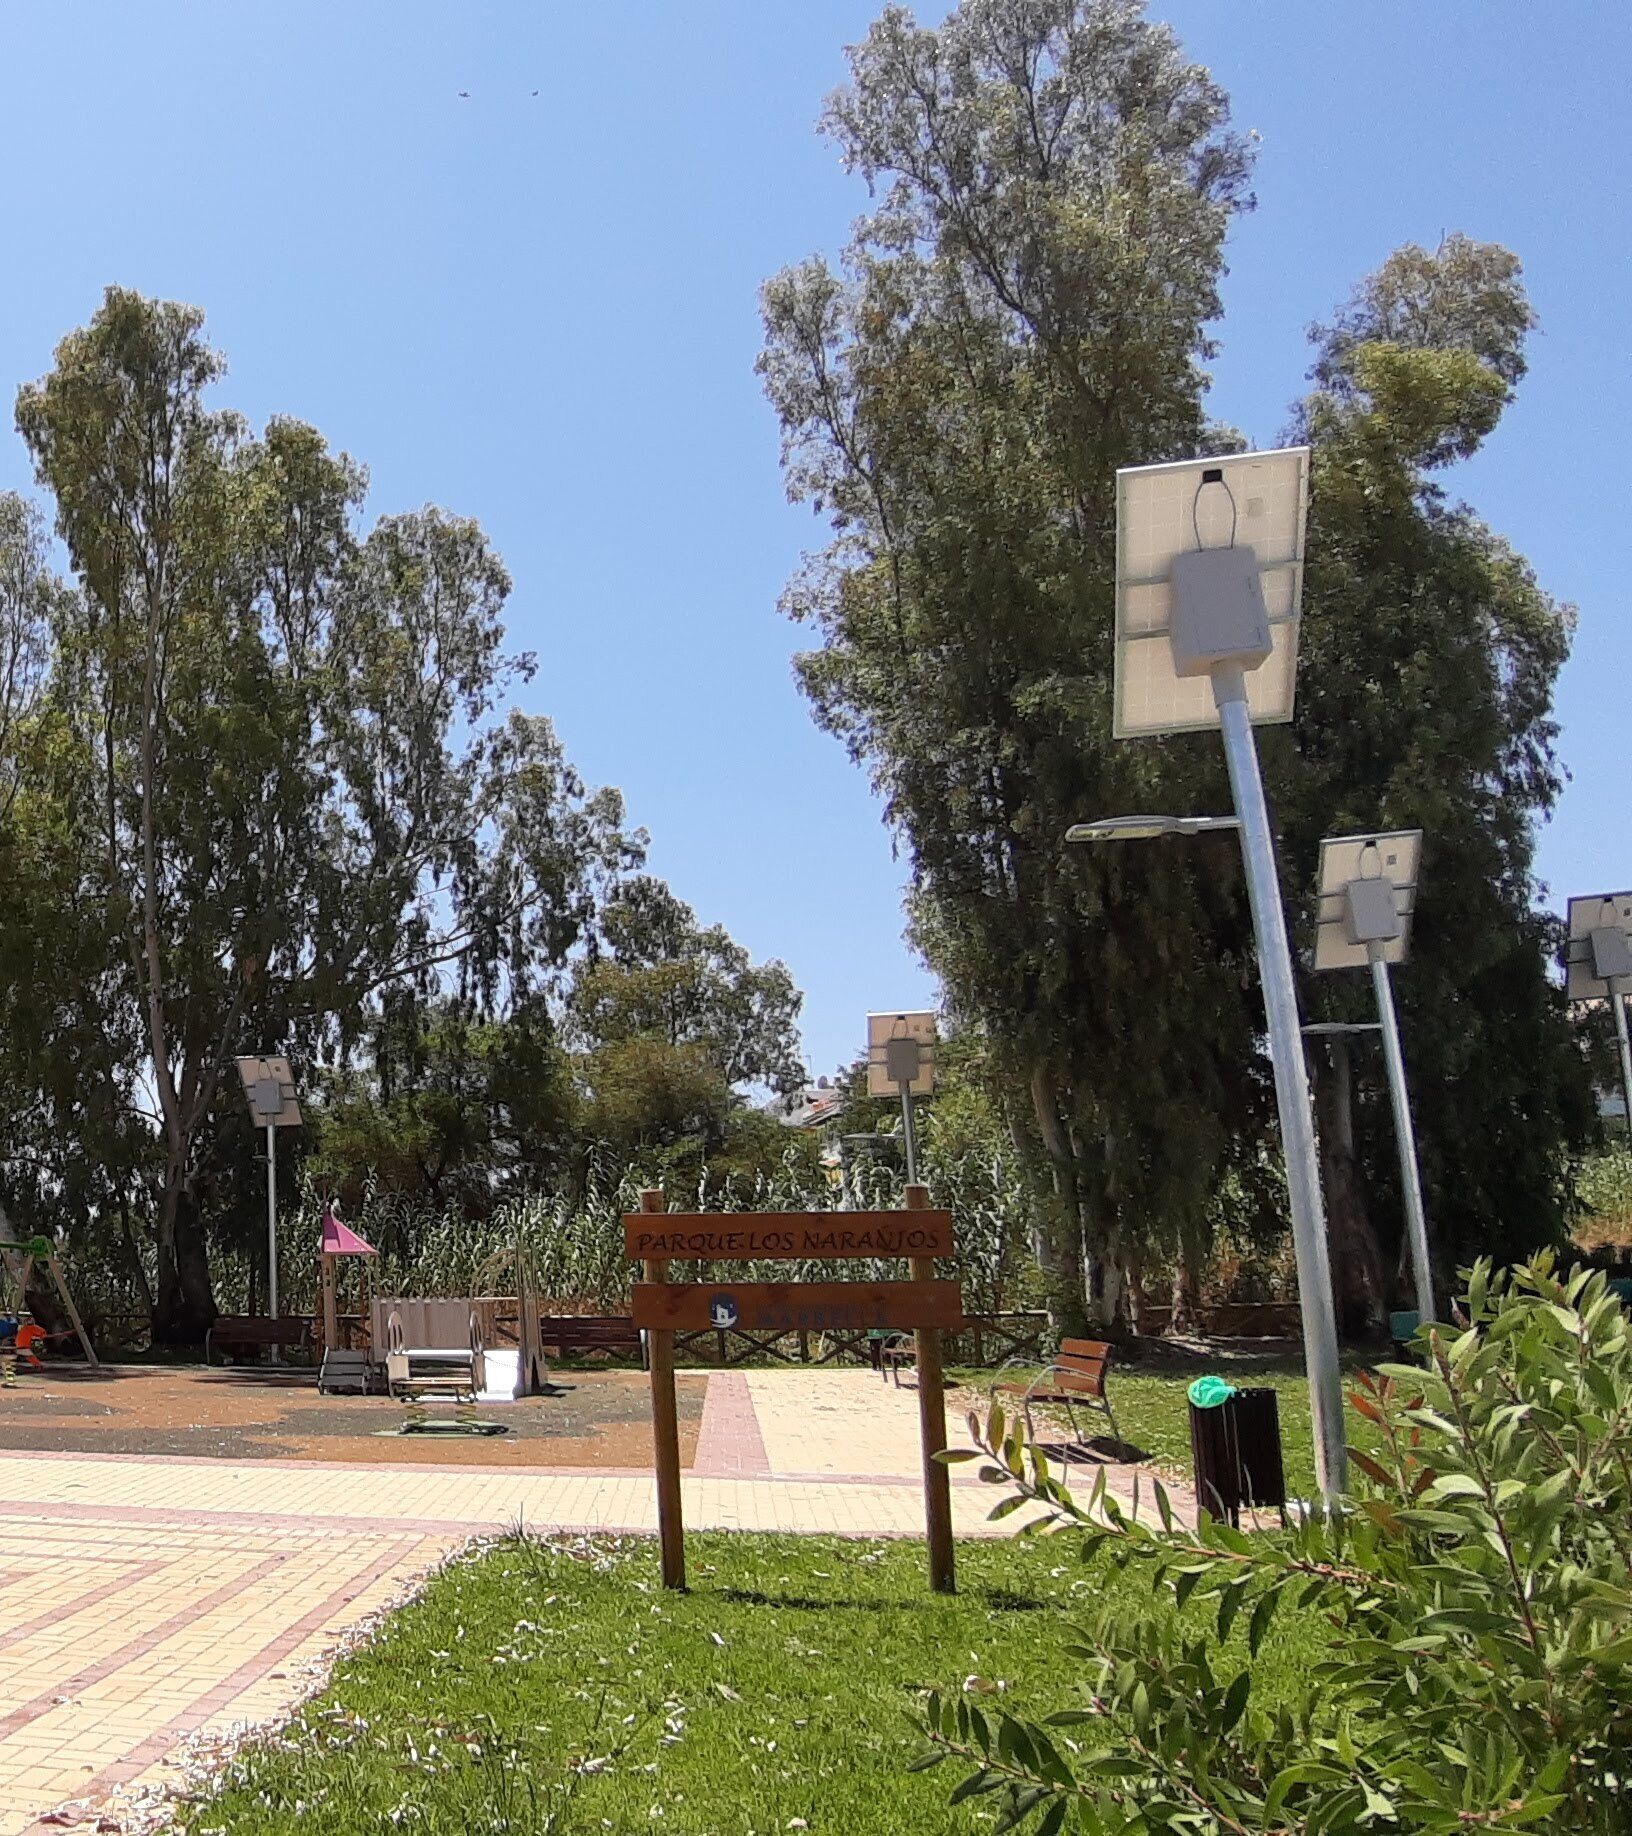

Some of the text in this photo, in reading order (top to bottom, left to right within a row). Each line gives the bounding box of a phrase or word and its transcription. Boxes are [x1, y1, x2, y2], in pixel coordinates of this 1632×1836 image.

[635, 1228, 939, 1255] PARQUE LOS NARANJOS
